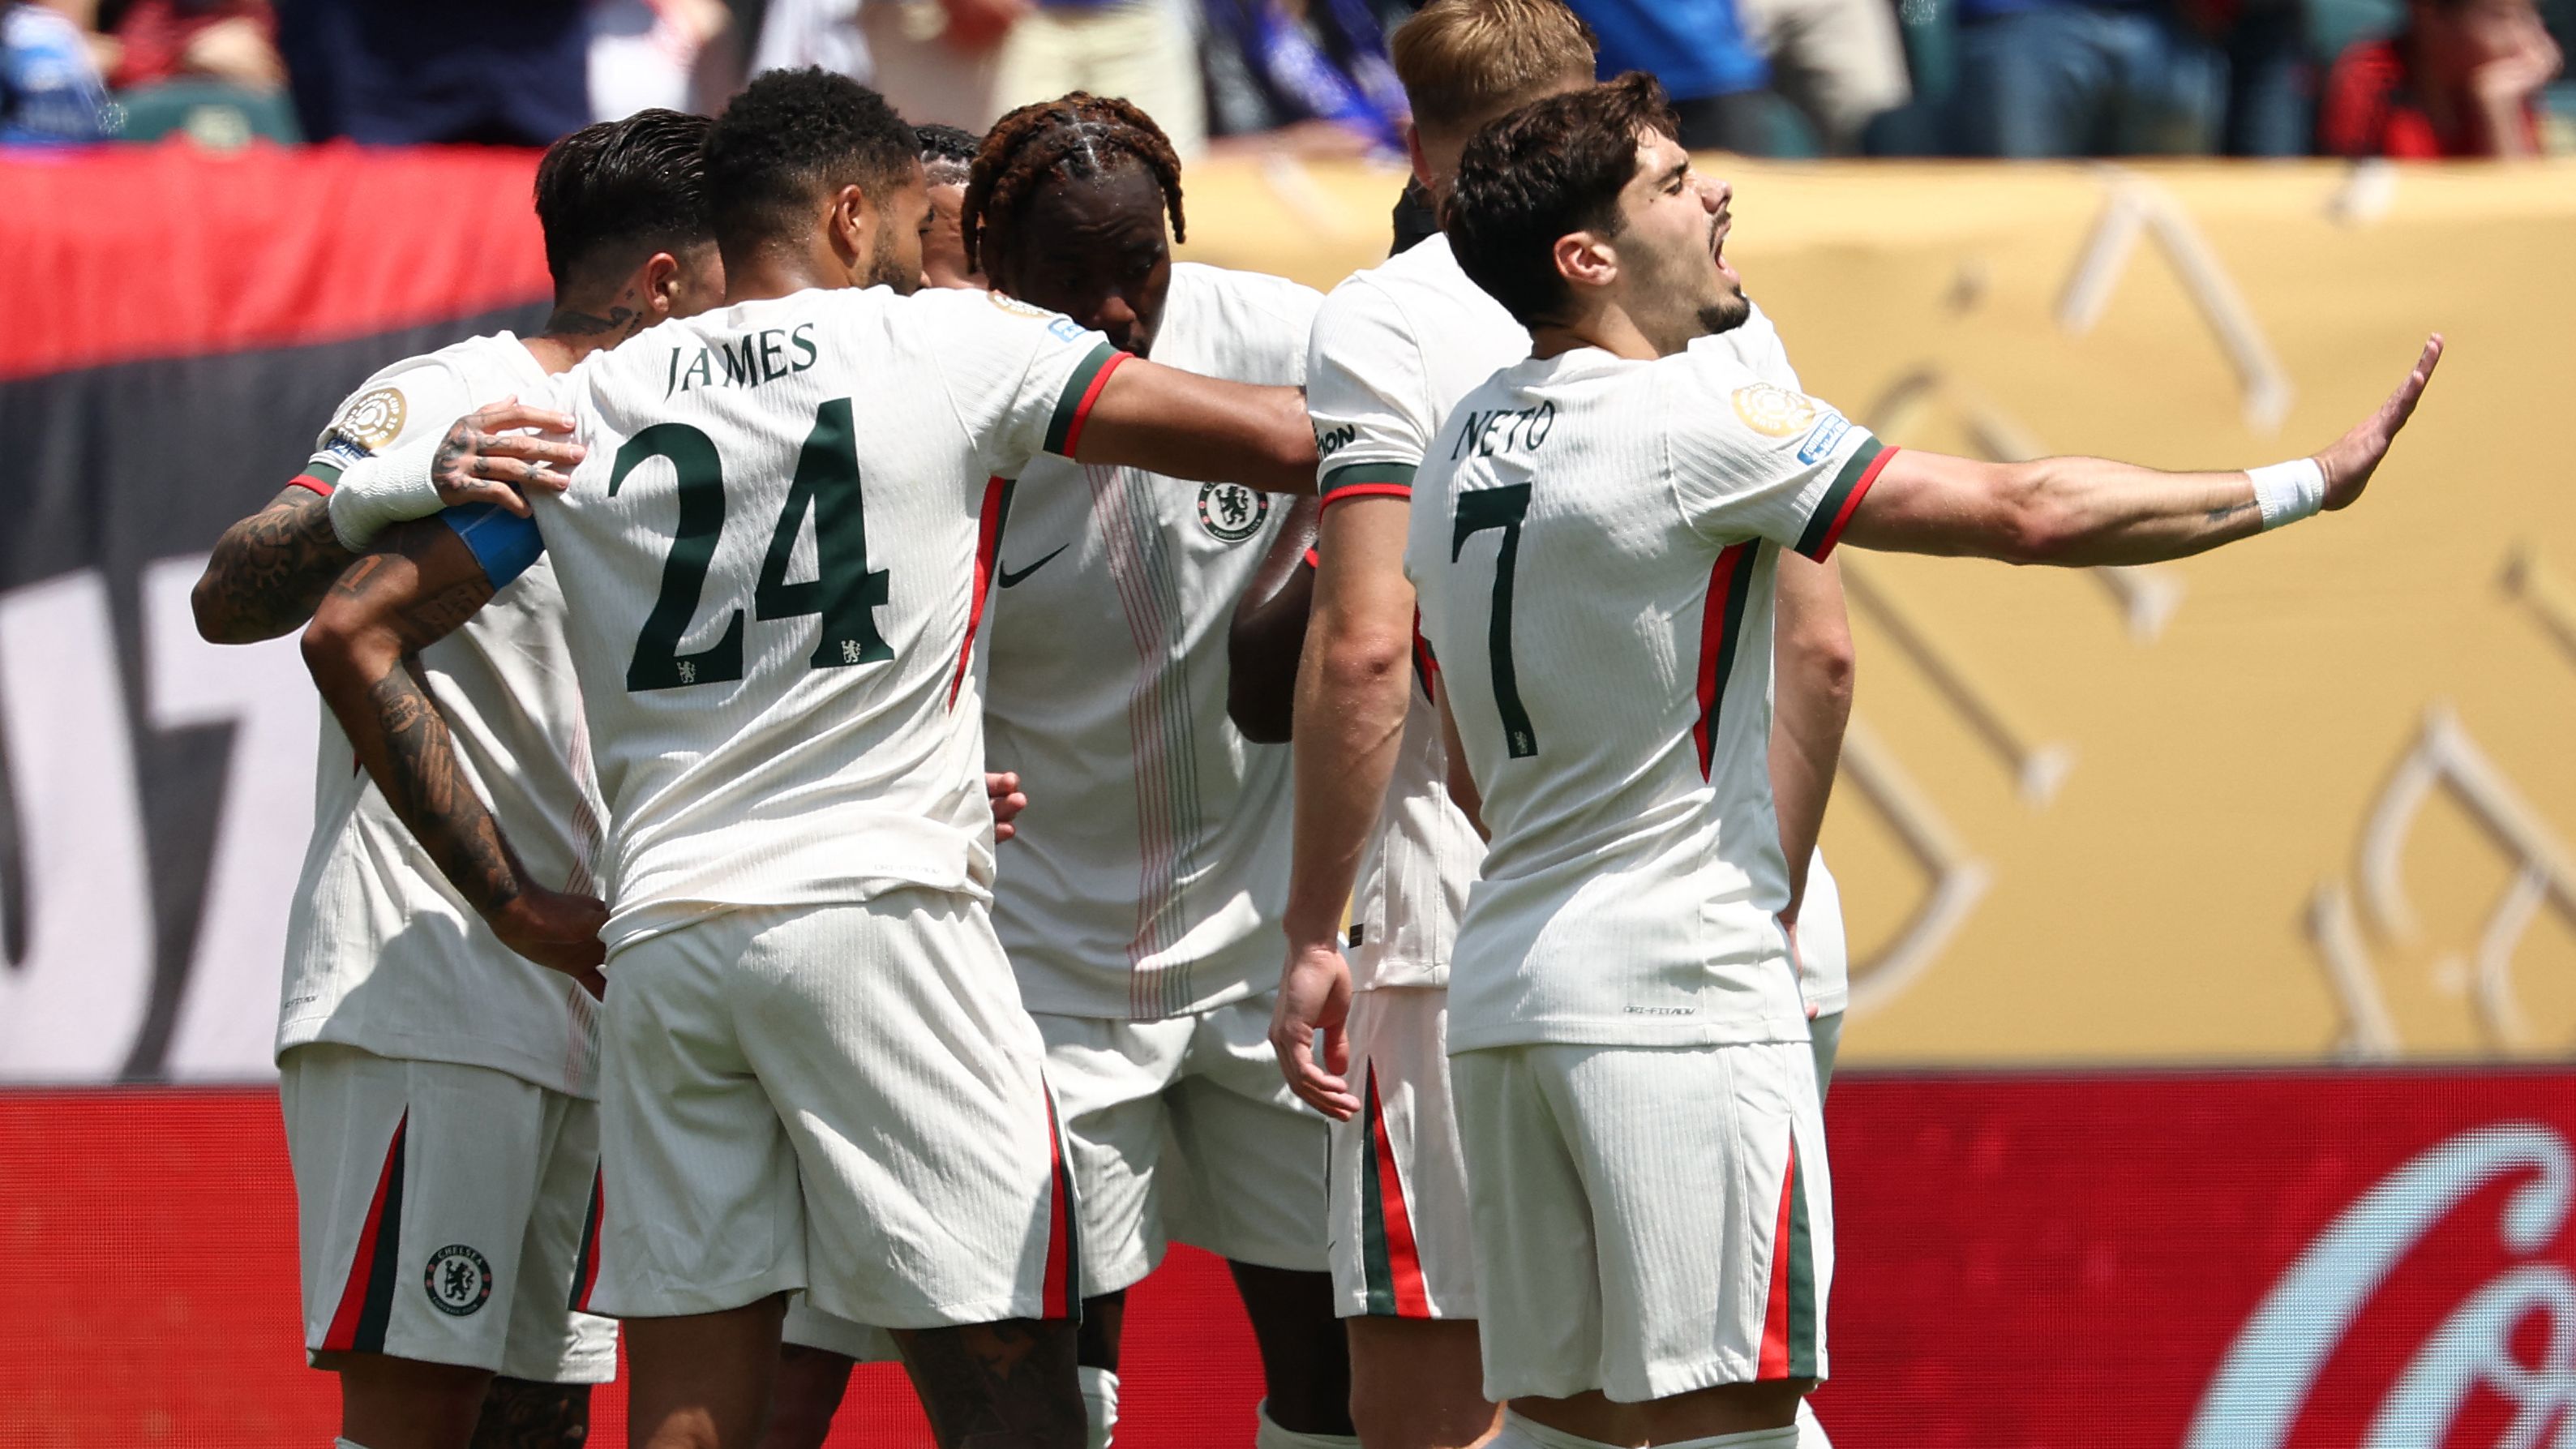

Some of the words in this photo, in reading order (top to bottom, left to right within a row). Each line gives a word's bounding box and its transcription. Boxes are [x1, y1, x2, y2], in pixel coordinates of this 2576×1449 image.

[663, 323, 817, 403] JAMES
[1451, 400, 1554, 461] NETO
[608, 397, 894, 692] 24
[1451, 482, 1539, 759] 7
